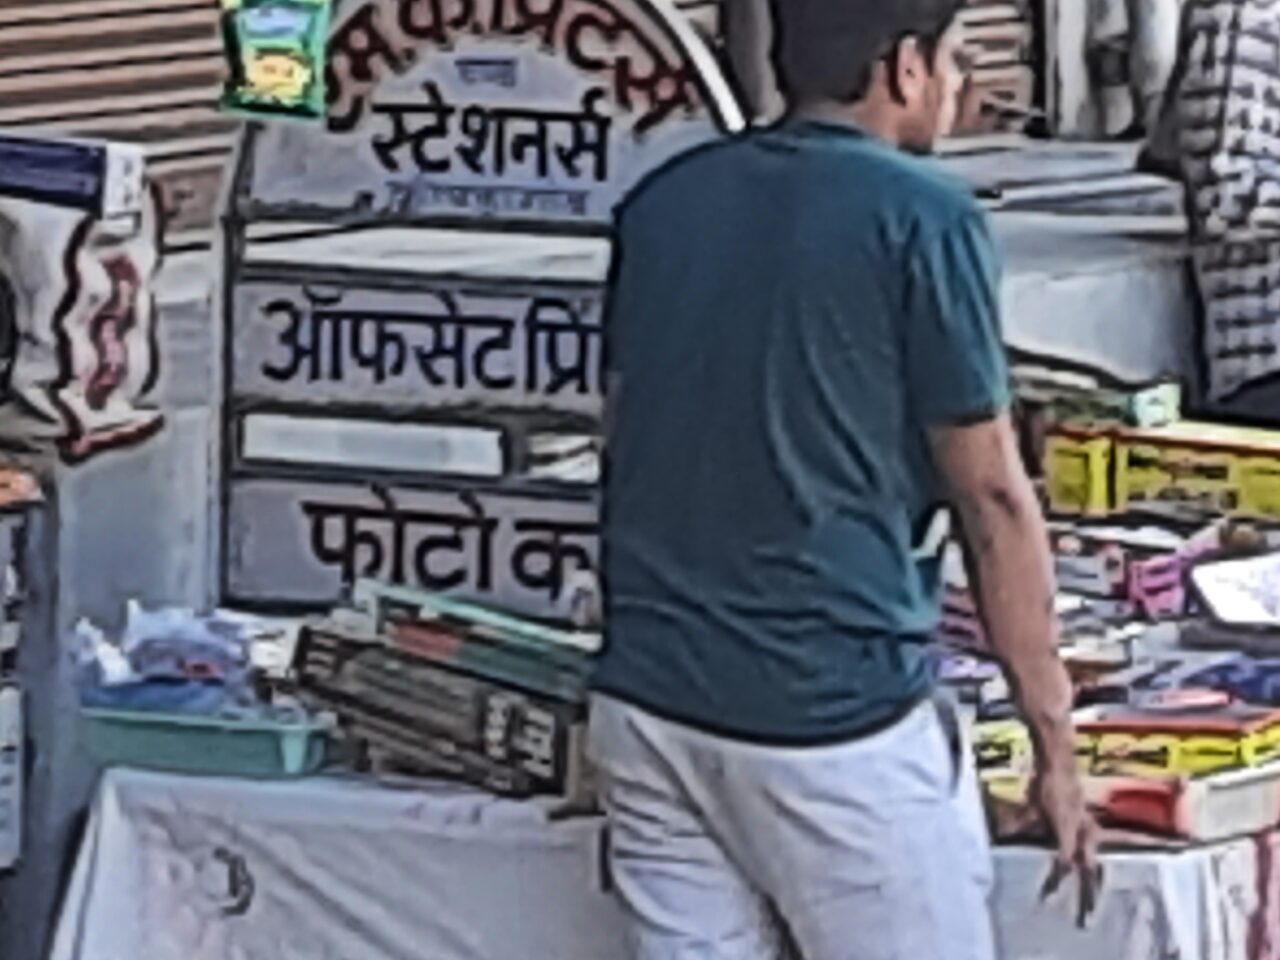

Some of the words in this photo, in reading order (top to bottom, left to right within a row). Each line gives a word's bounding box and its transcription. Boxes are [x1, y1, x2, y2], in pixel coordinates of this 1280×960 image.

[371, 82, 612, 181] स्टेशनर्स
[523, 297, 606, 396] प्रिं
[302, 484, 499, 592] फोटो
